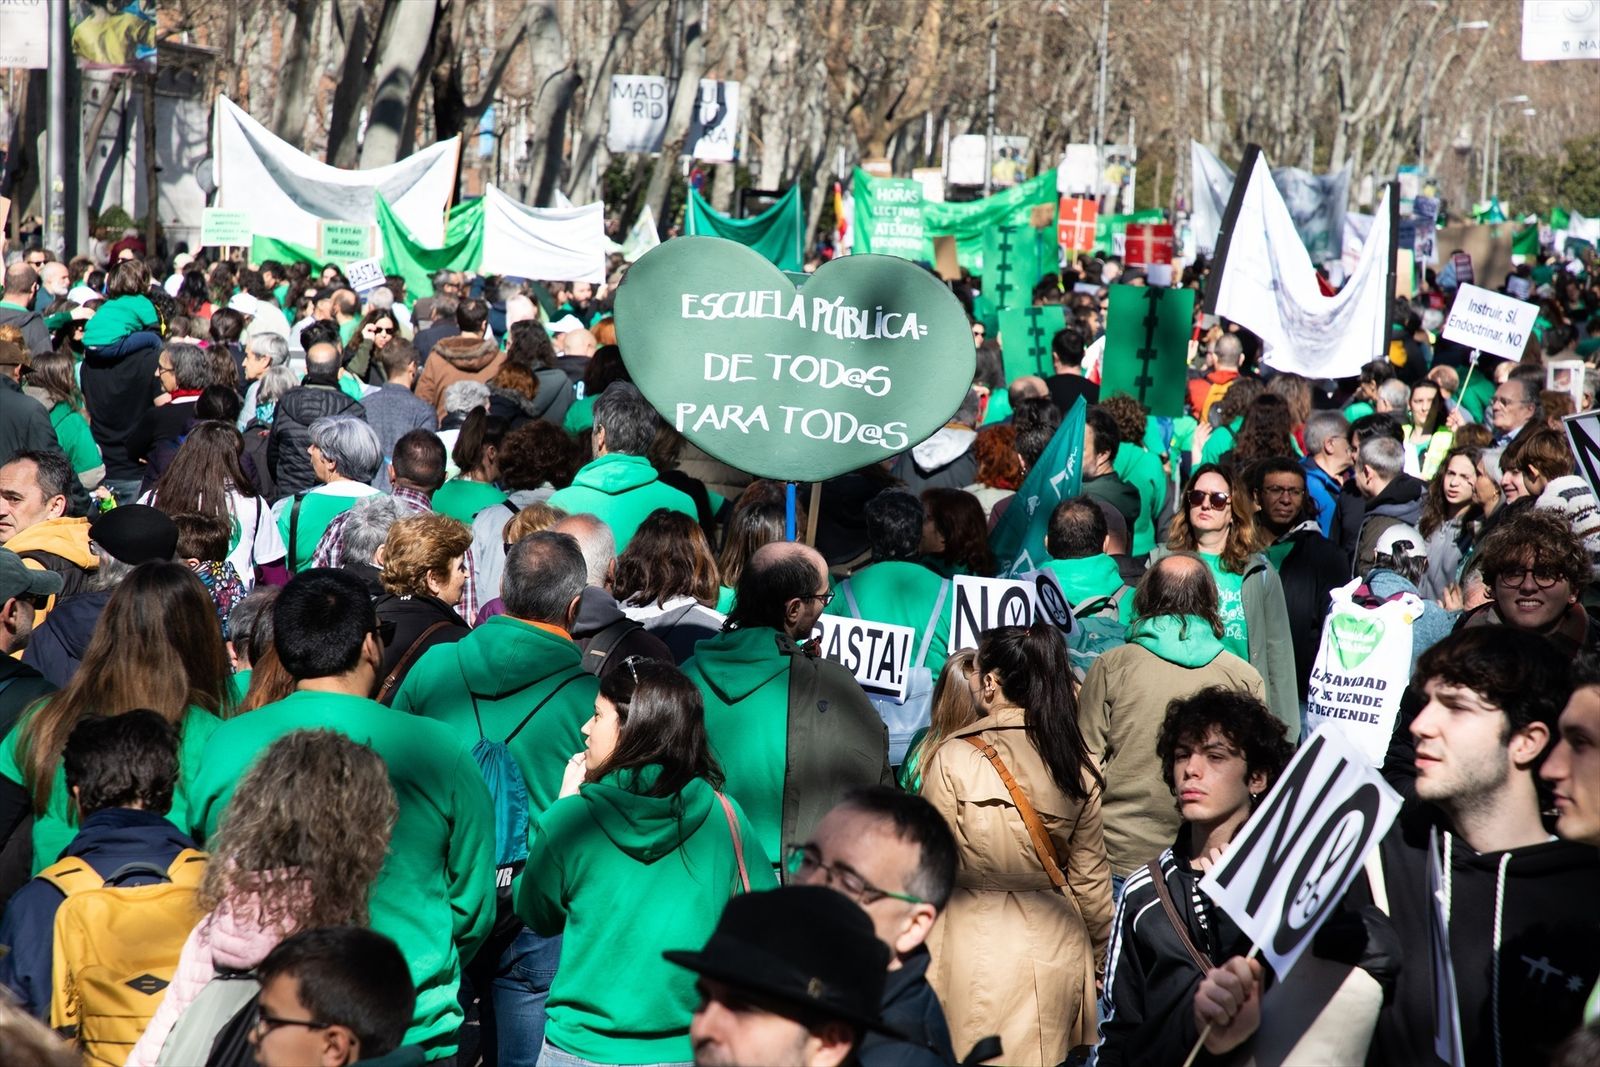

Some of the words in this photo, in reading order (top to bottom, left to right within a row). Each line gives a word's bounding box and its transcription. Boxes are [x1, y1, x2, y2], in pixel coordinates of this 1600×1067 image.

[1578, 40, 1600, 50] MA
[612, 82, 665, 101] MAD
[632, 101, 664, 120] RID
[876, 187, 919, 204] HORAS
[681, 290, 806, 328] ESCUELA
[704, 352, 757, 383] DE
[765, 353, 892, 397] TOD@S
[676, 402, 770, 434] PARA
[778, 405, 909, 450] TOD@S
[1337, 692, 1384, 708] VENDE
[1315, 703, 1380, 725] DEFIENDE
[1215, 734, 1380, 956] NO
